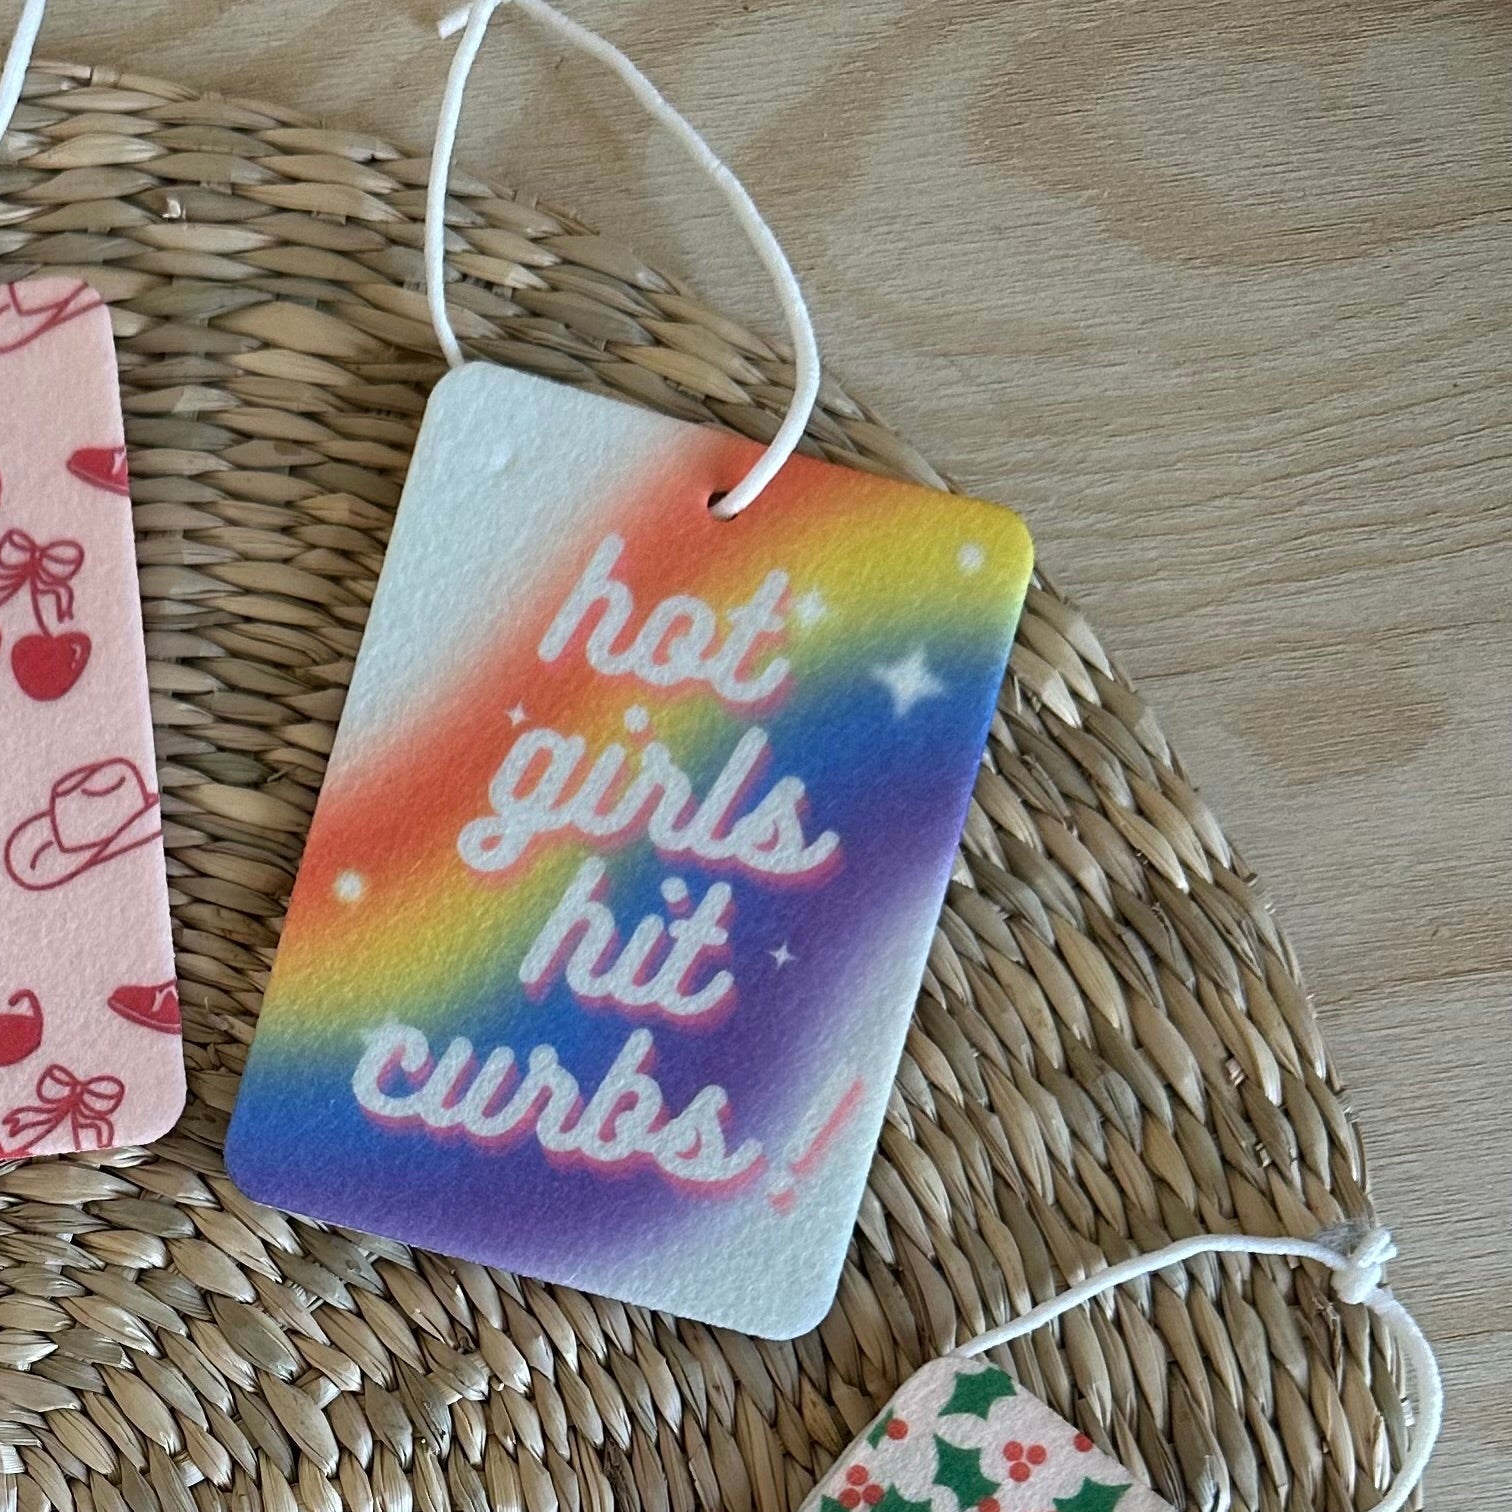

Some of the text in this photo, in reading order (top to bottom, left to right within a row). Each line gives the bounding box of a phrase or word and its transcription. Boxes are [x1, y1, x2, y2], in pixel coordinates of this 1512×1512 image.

[537, 532, 791, 708] hot
[456, 704, 842, 880] girls
[518, 855, 734, 1024] hit
[351, 1023, 866, 1210] curbs!
